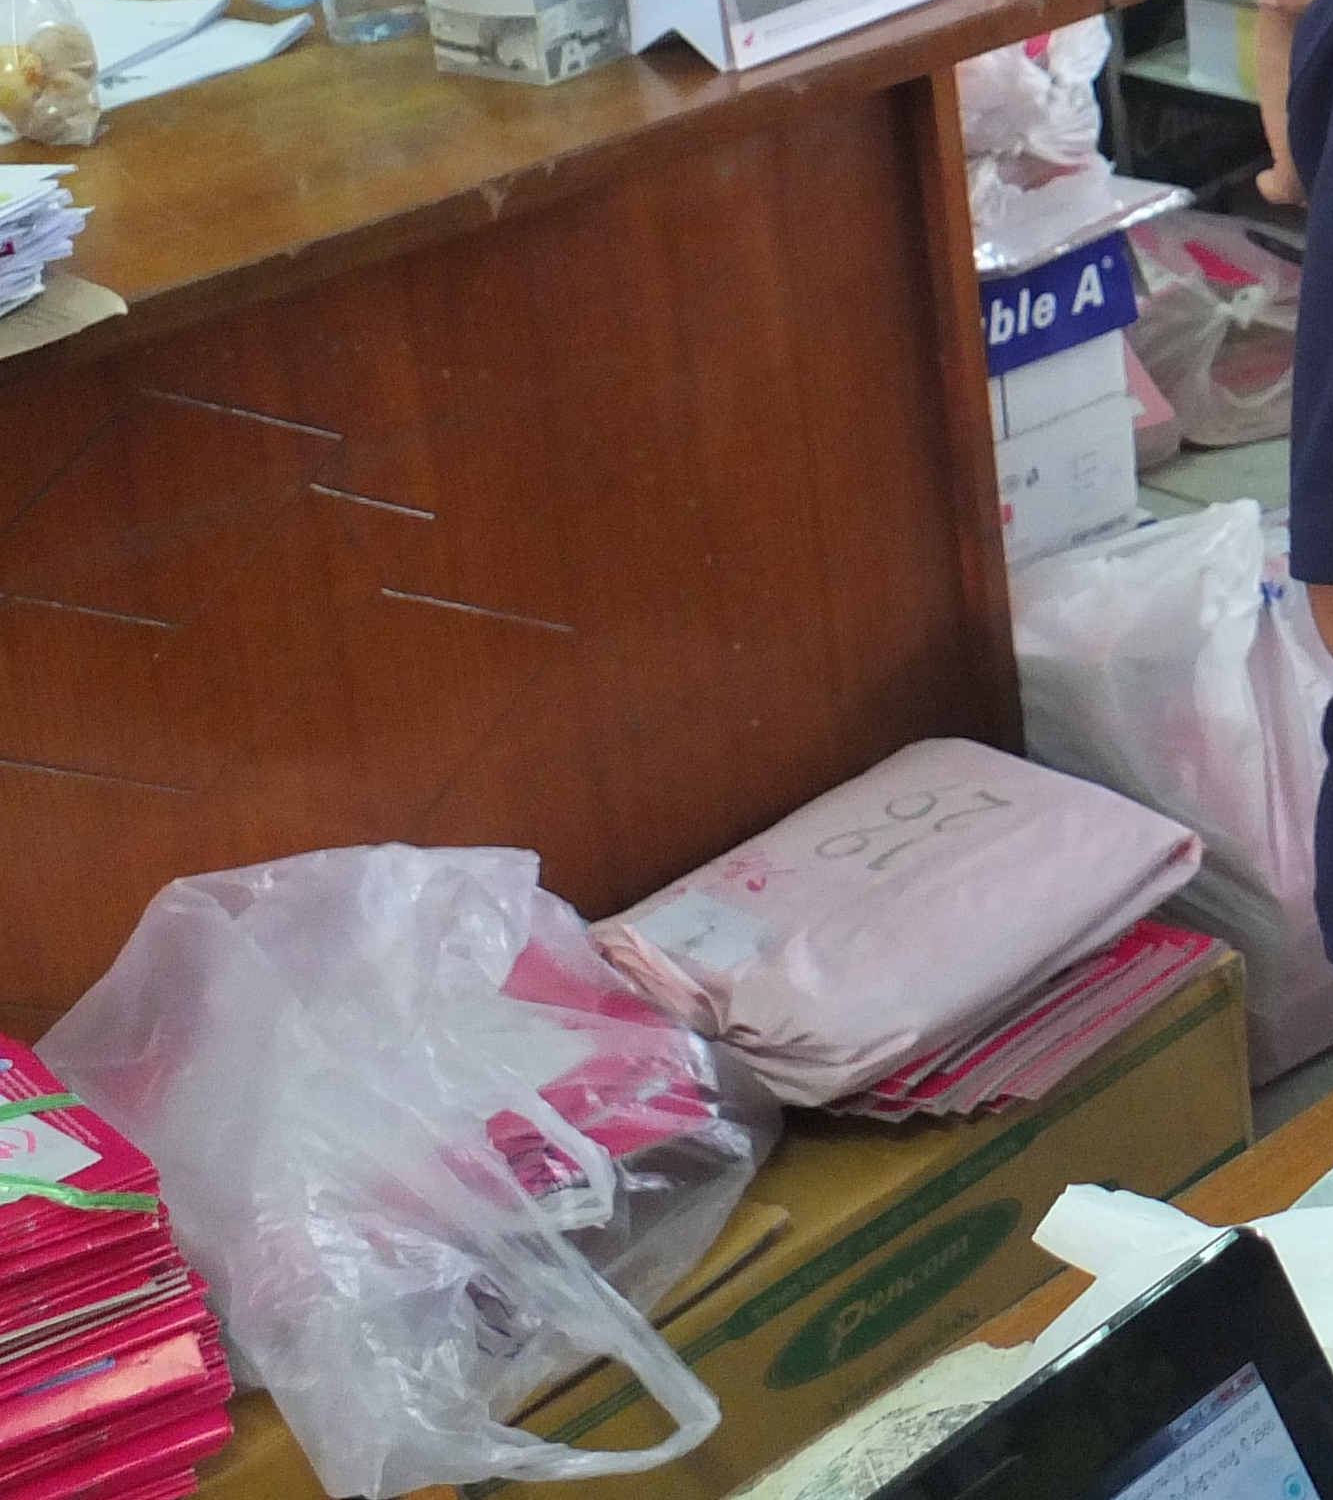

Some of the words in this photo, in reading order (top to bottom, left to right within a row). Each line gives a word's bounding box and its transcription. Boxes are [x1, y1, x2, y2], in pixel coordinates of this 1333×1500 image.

[981, 287, 1057, 345] ble
[1072, 264, 1105, 315] A
[828, 1230, 970, 1362] Pencom
